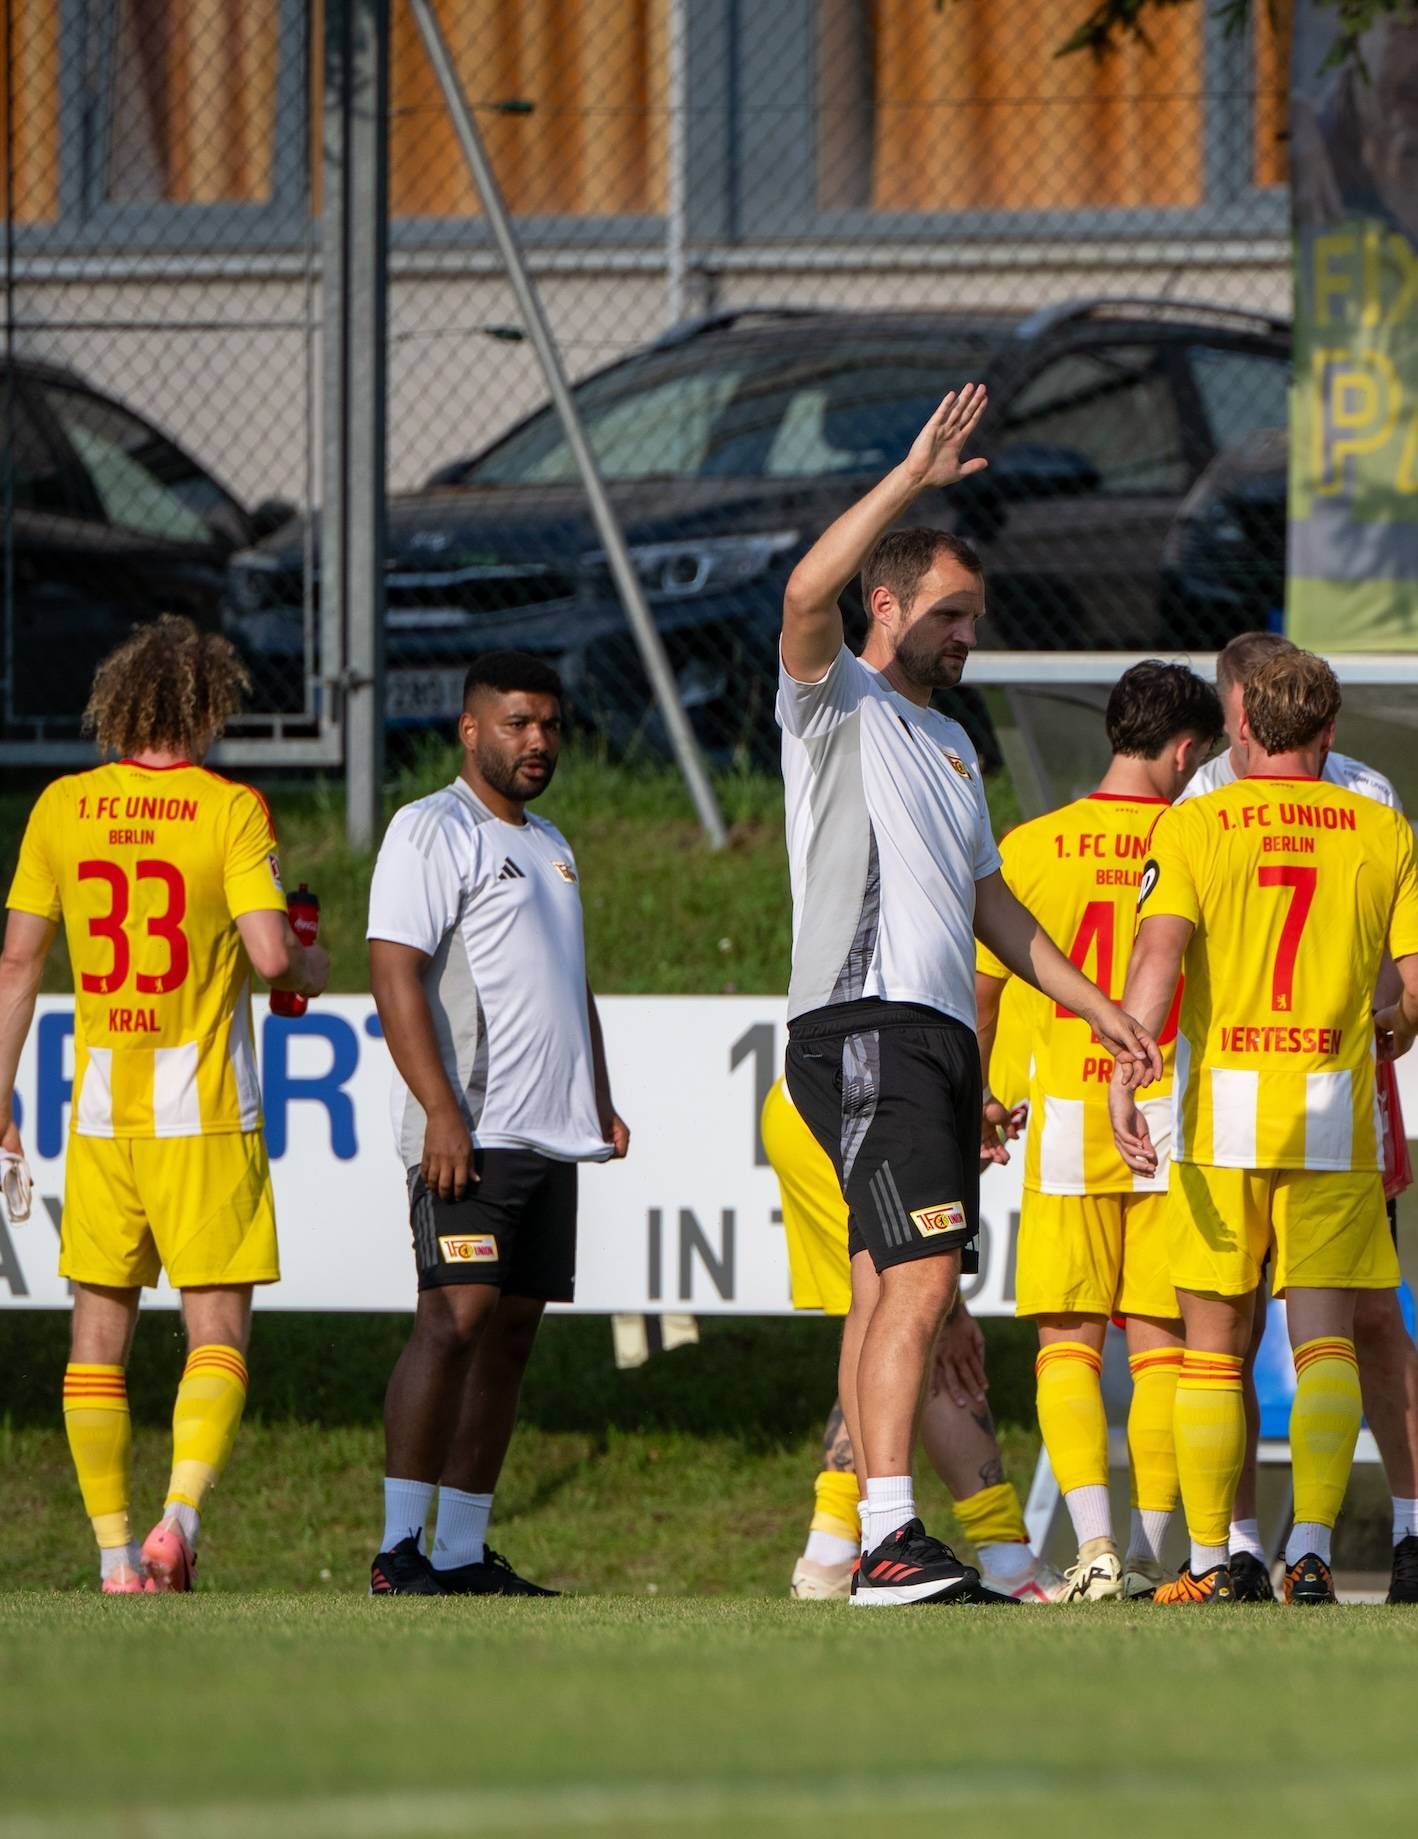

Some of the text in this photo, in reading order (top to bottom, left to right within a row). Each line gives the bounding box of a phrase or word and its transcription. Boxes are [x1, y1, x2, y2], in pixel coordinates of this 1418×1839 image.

[79, 796, 198, 821] 1. FC UNION
[1218, 803, 1357, 832] 1. FC UNION
[109, 829, 155, 845] BERLIN
[1055, 834, 1071, 858] 1.
[1079, 833, 1107, 858] FC
[1263, 836, 1315, 854] BERLIN
[78, 859, 190, 995] 33
[1258, 865, 1318, 1012] 7
[108, 1008, 162, 1033] KRAL
[1221, 1026, 1343, 1056] VERTESSEN
[648, 1208, 736, 1302] IN
